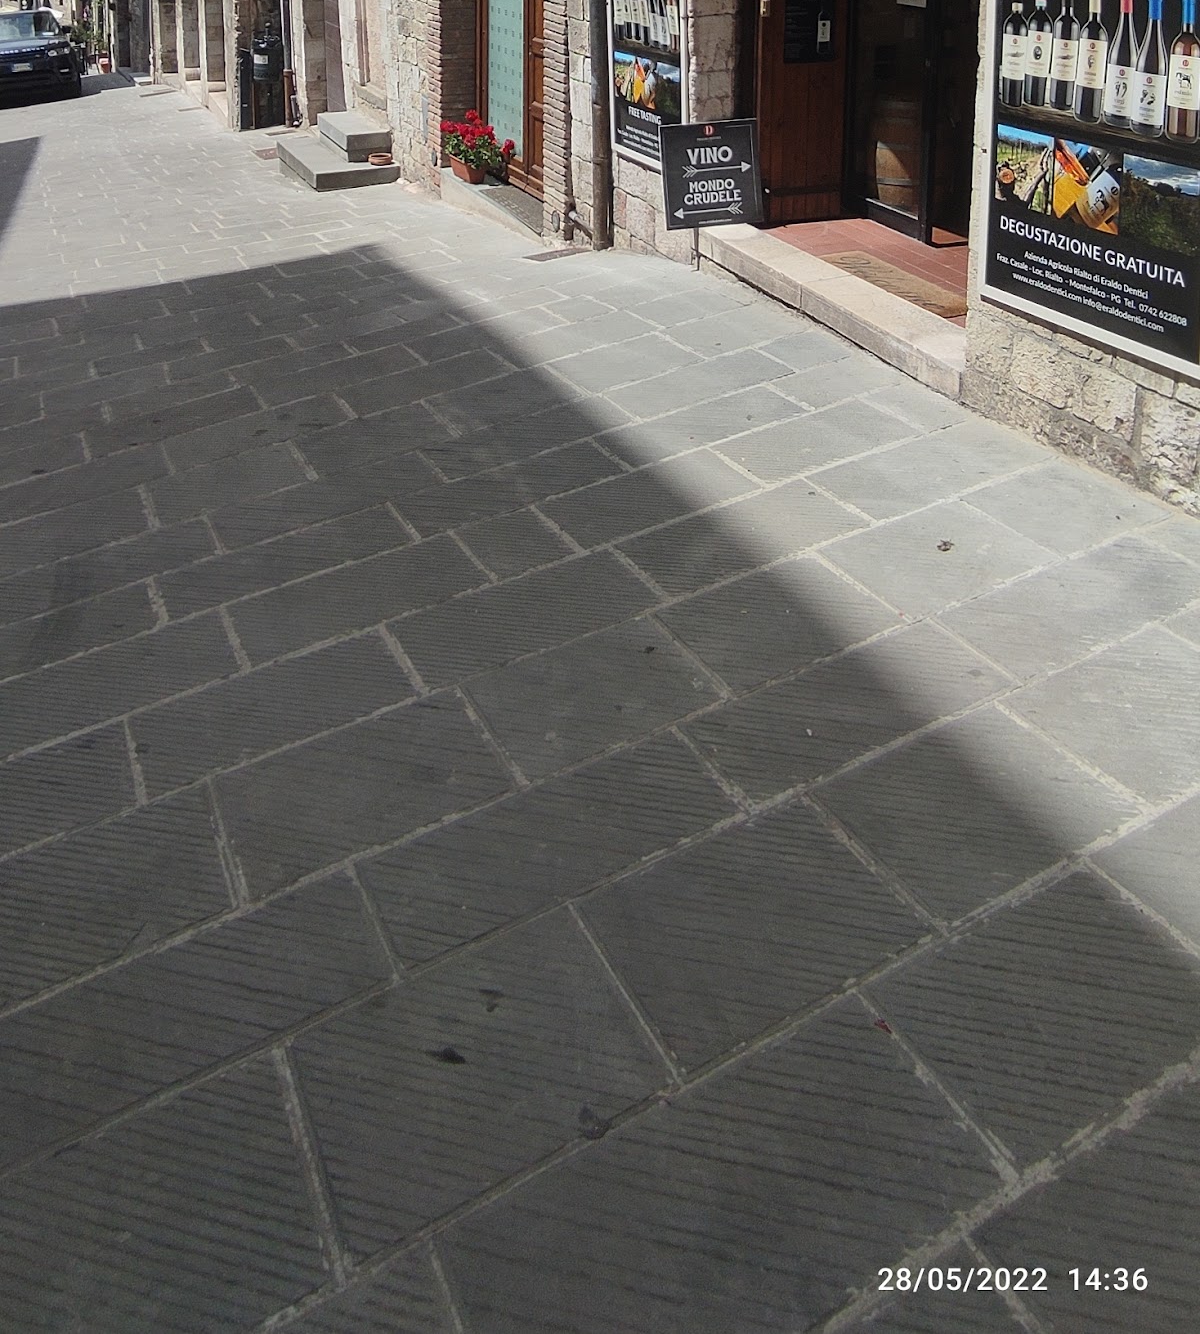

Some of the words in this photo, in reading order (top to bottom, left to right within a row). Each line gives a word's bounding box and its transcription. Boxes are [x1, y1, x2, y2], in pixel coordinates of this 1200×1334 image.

[628, 106, 640, 119] FREE
[640, 110, 662, 125] TASTING
[686, 146, 733, 165] VINO
[684, 189, 742, 205] CRUDELE
[689, 179, 735, 193] MONDO
[1000, 215, 1101, 262] DEGUSTAZIONE
[1104, 249, 1185, 288] GRATUITA
[1010, 258, 1028, 271] Casale
[1045, 270, 1063, 283] Rialto
[1069, 278, 1106, 298] Montefalco
[1111, 293, 1121, 304] PG
[1124, 297, 1136, 309] Tel.
[1138, 303, 1158, 317] 0742
[1158, 310, 1187, 326] 622808
[1024, 251, 1048, 265] Azienda
[1048, 259, 1073, 274] Agricola
[1073, 267, 1092, 280] Rialto
[1093, 274, 1100, 283] di
[1101, 276, 1122, 291] Eraldo
[1123, 284, 1148, 300] Dentici
[1012, 272, 1082, 303] www.eraldodentici.com
[1082, 295, 1164, 333] info@eraldodentici.com
